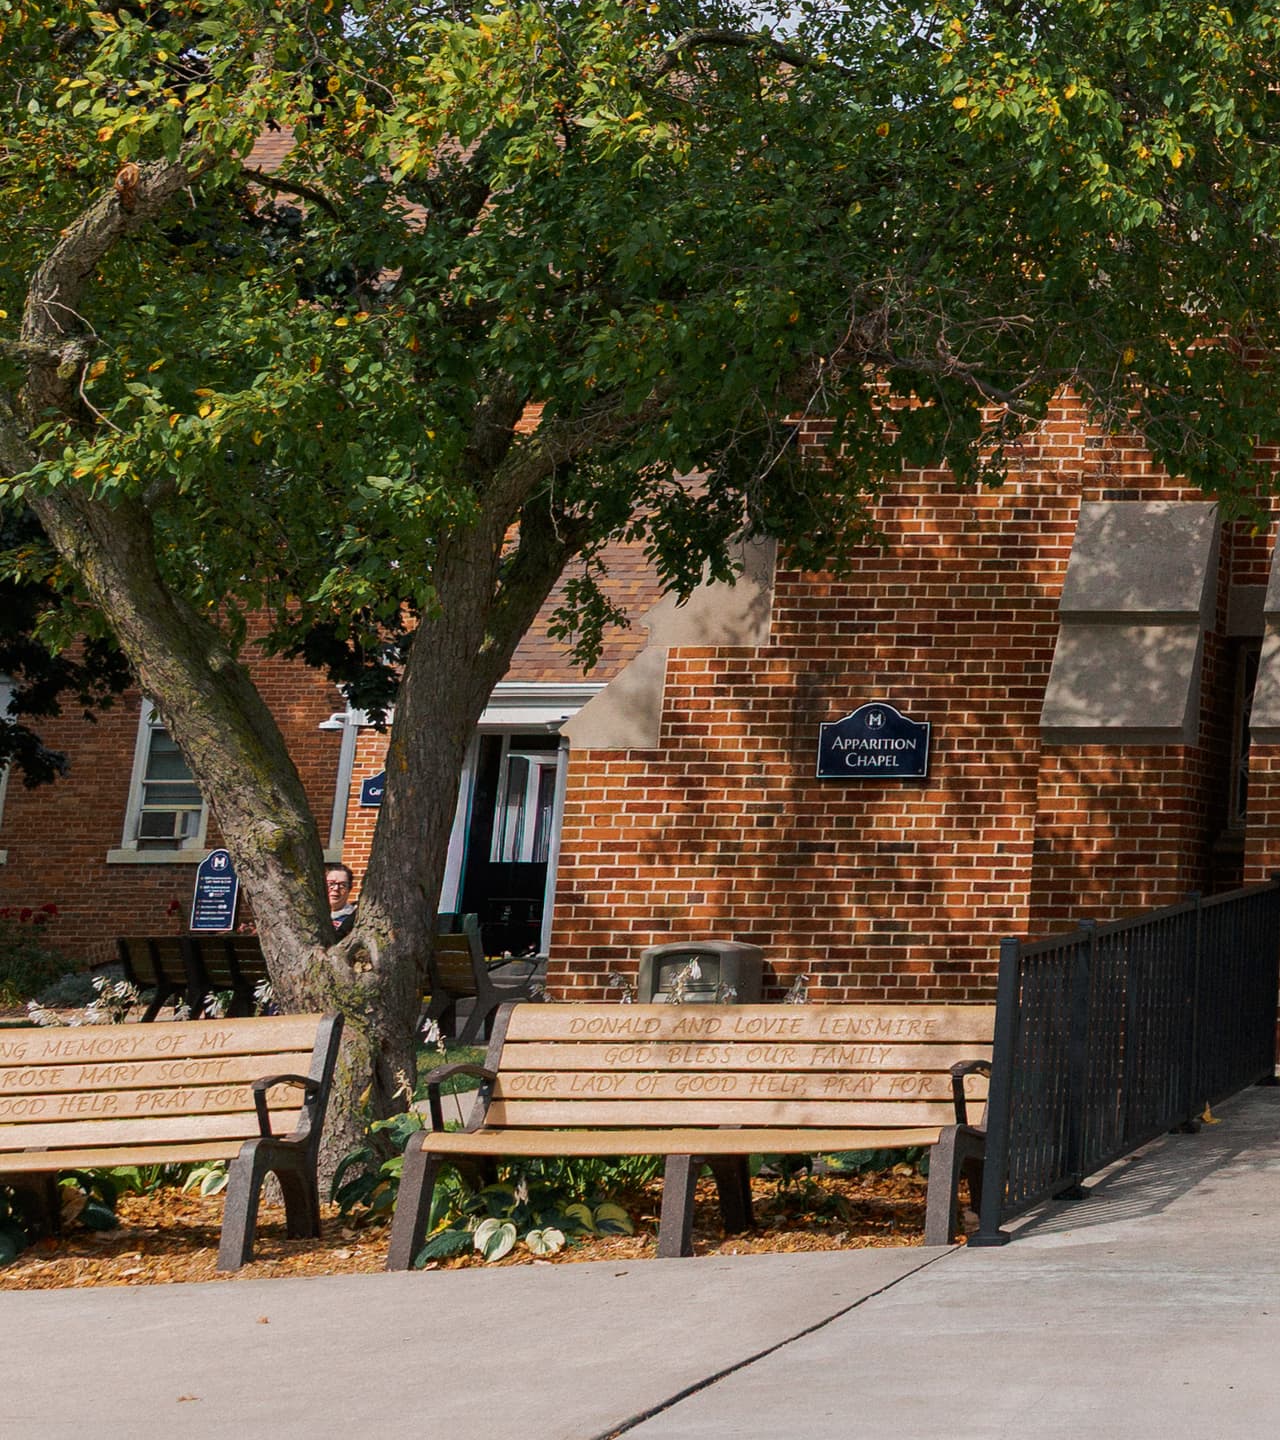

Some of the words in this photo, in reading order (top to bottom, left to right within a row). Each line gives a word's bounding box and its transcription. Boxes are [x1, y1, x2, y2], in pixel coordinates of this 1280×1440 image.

[831, 735, 917, 750] APPARITION
[845, 752, 900, 767] CHAPEL
[569, 1016, 662, 1035] DONALD
[672, 1016, 722, 1035] AND
[733, 1016, 804, 1035] LOVIE
[818, 1016, 938, 1037] LENSMIRE
[41, 1036, 146, 1057] MEMORY
[155, 1034, 187, 1053] OF
[199, 1031, 234, 1050] MY
[604, 1046, 652, 1065] GOD
[667, 1045, 734, 1065] BLESS
[746, 1046, 797, 1066] OUR
[808, 1046, 893, 1066] FAMILY
[2, 1068, 65, 1089] ROSE
[77, 1064, 145, 1084] MARY
[156, 1059, 232, 1081] SCOTT
[510, 1074, 557, 1093] OUR
[570, 1074, 627, 1093] LADY
[635, 1075, 668, 1095] OF
[674, 1074, 738, 1094] GOOD
[749, 1074, 808, 1096] HELP,
[823, 1076, 881, 1095] PRAY
[888, 1076, 934, 1095] FOR
[135, 1090, 194, 1111] PRAY
[201, 1087, 249, 1110] FOR
